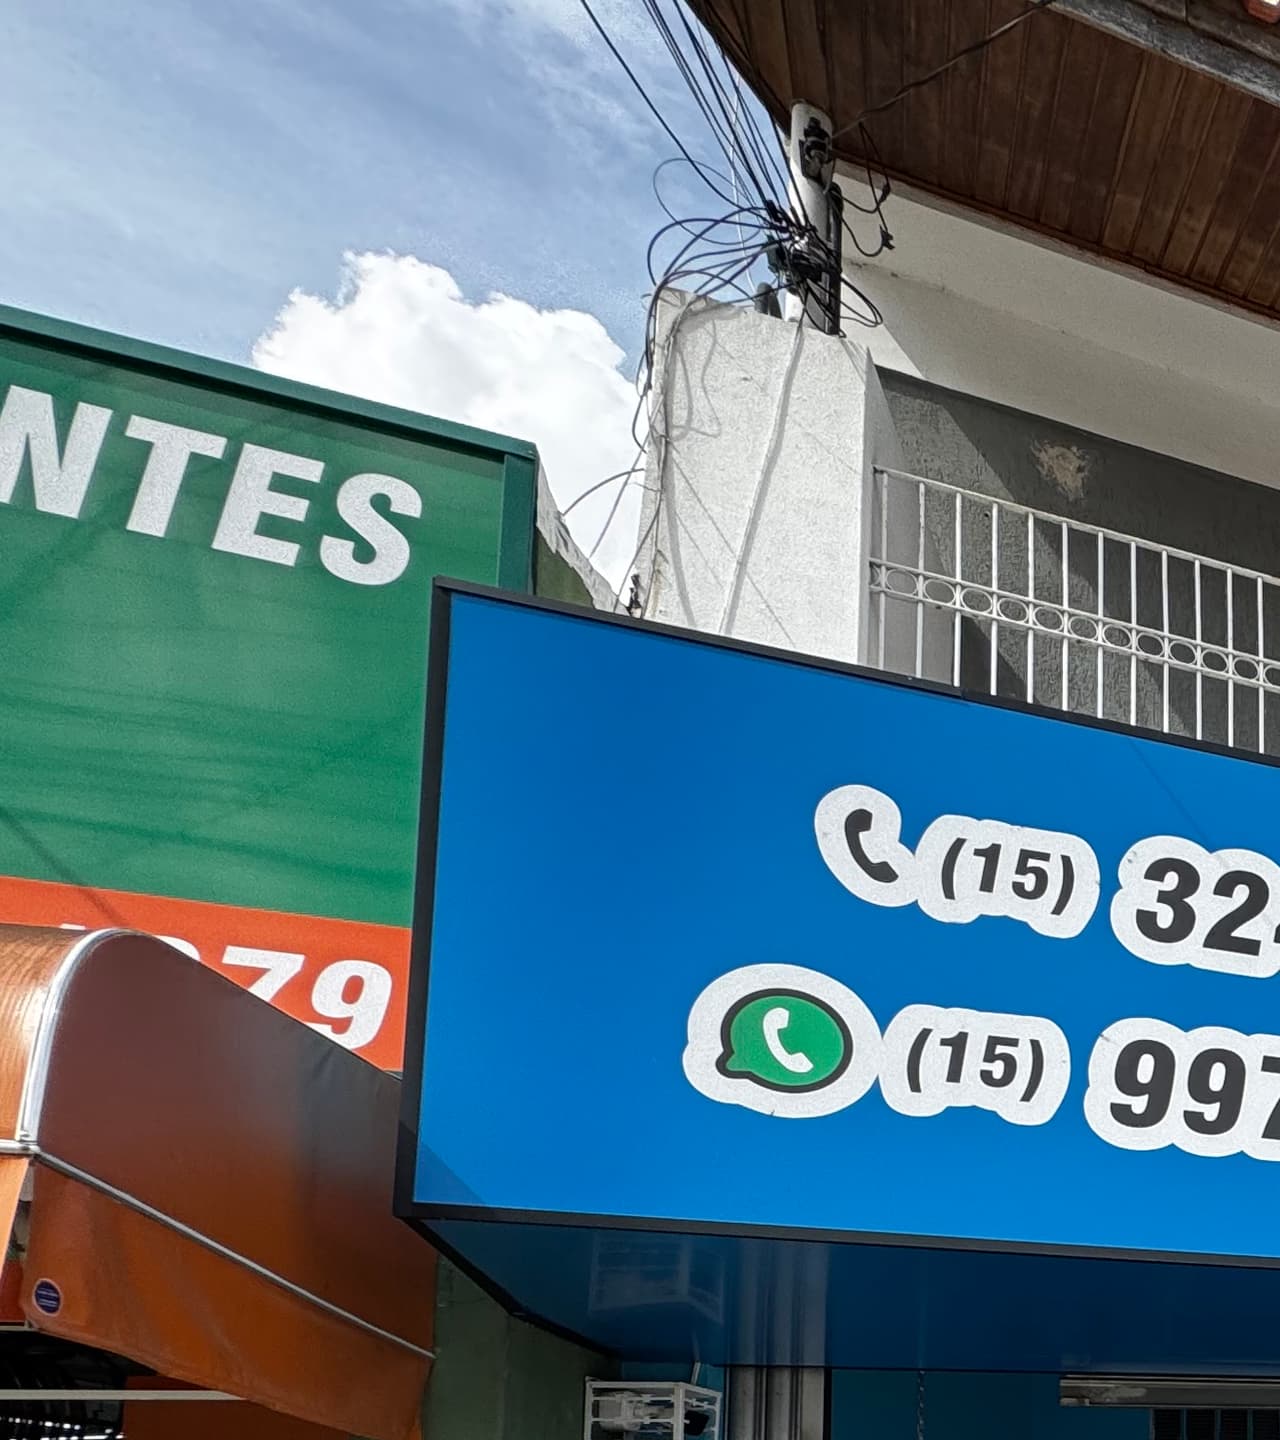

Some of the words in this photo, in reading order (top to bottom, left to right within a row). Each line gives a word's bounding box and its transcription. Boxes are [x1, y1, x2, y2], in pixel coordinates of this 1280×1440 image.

[0, 384, 423, 586] NTES
[940, 836, 1076, 917] (15)
[906, 1026, 1045, 1103] (15)
